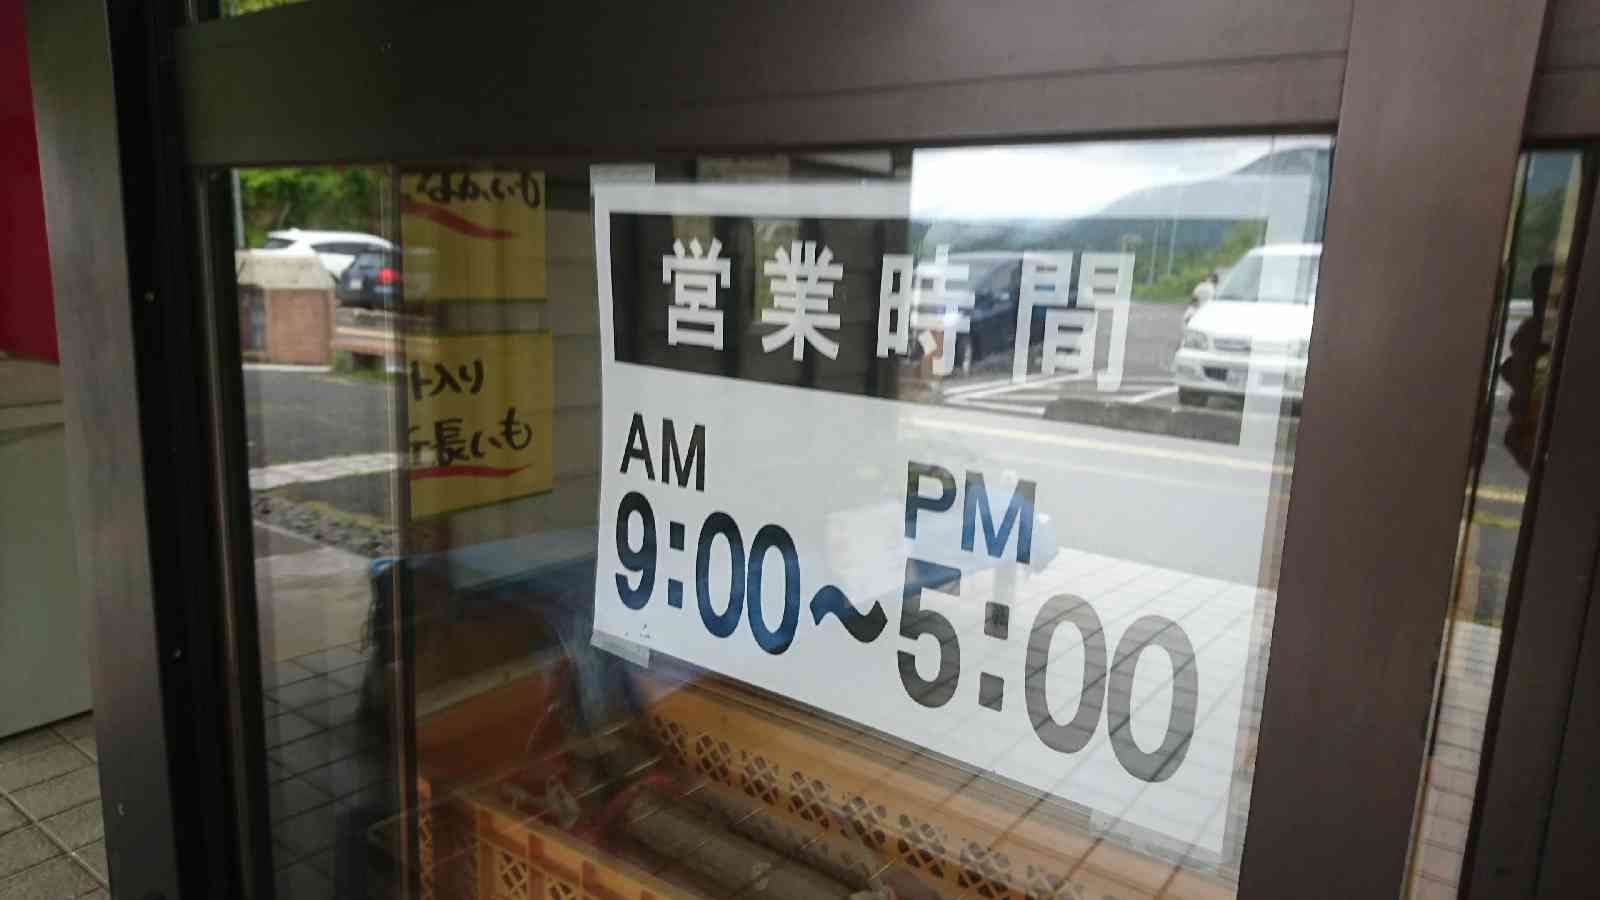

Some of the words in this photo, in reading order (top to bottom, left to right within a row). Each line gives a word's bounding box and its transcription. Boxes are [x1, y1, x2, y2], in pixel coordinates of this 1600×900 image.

[661, 238, 1136, 393] 営業時間
[619, 413, 706, 491] AM
[904, 460, 1037, 565] PM
